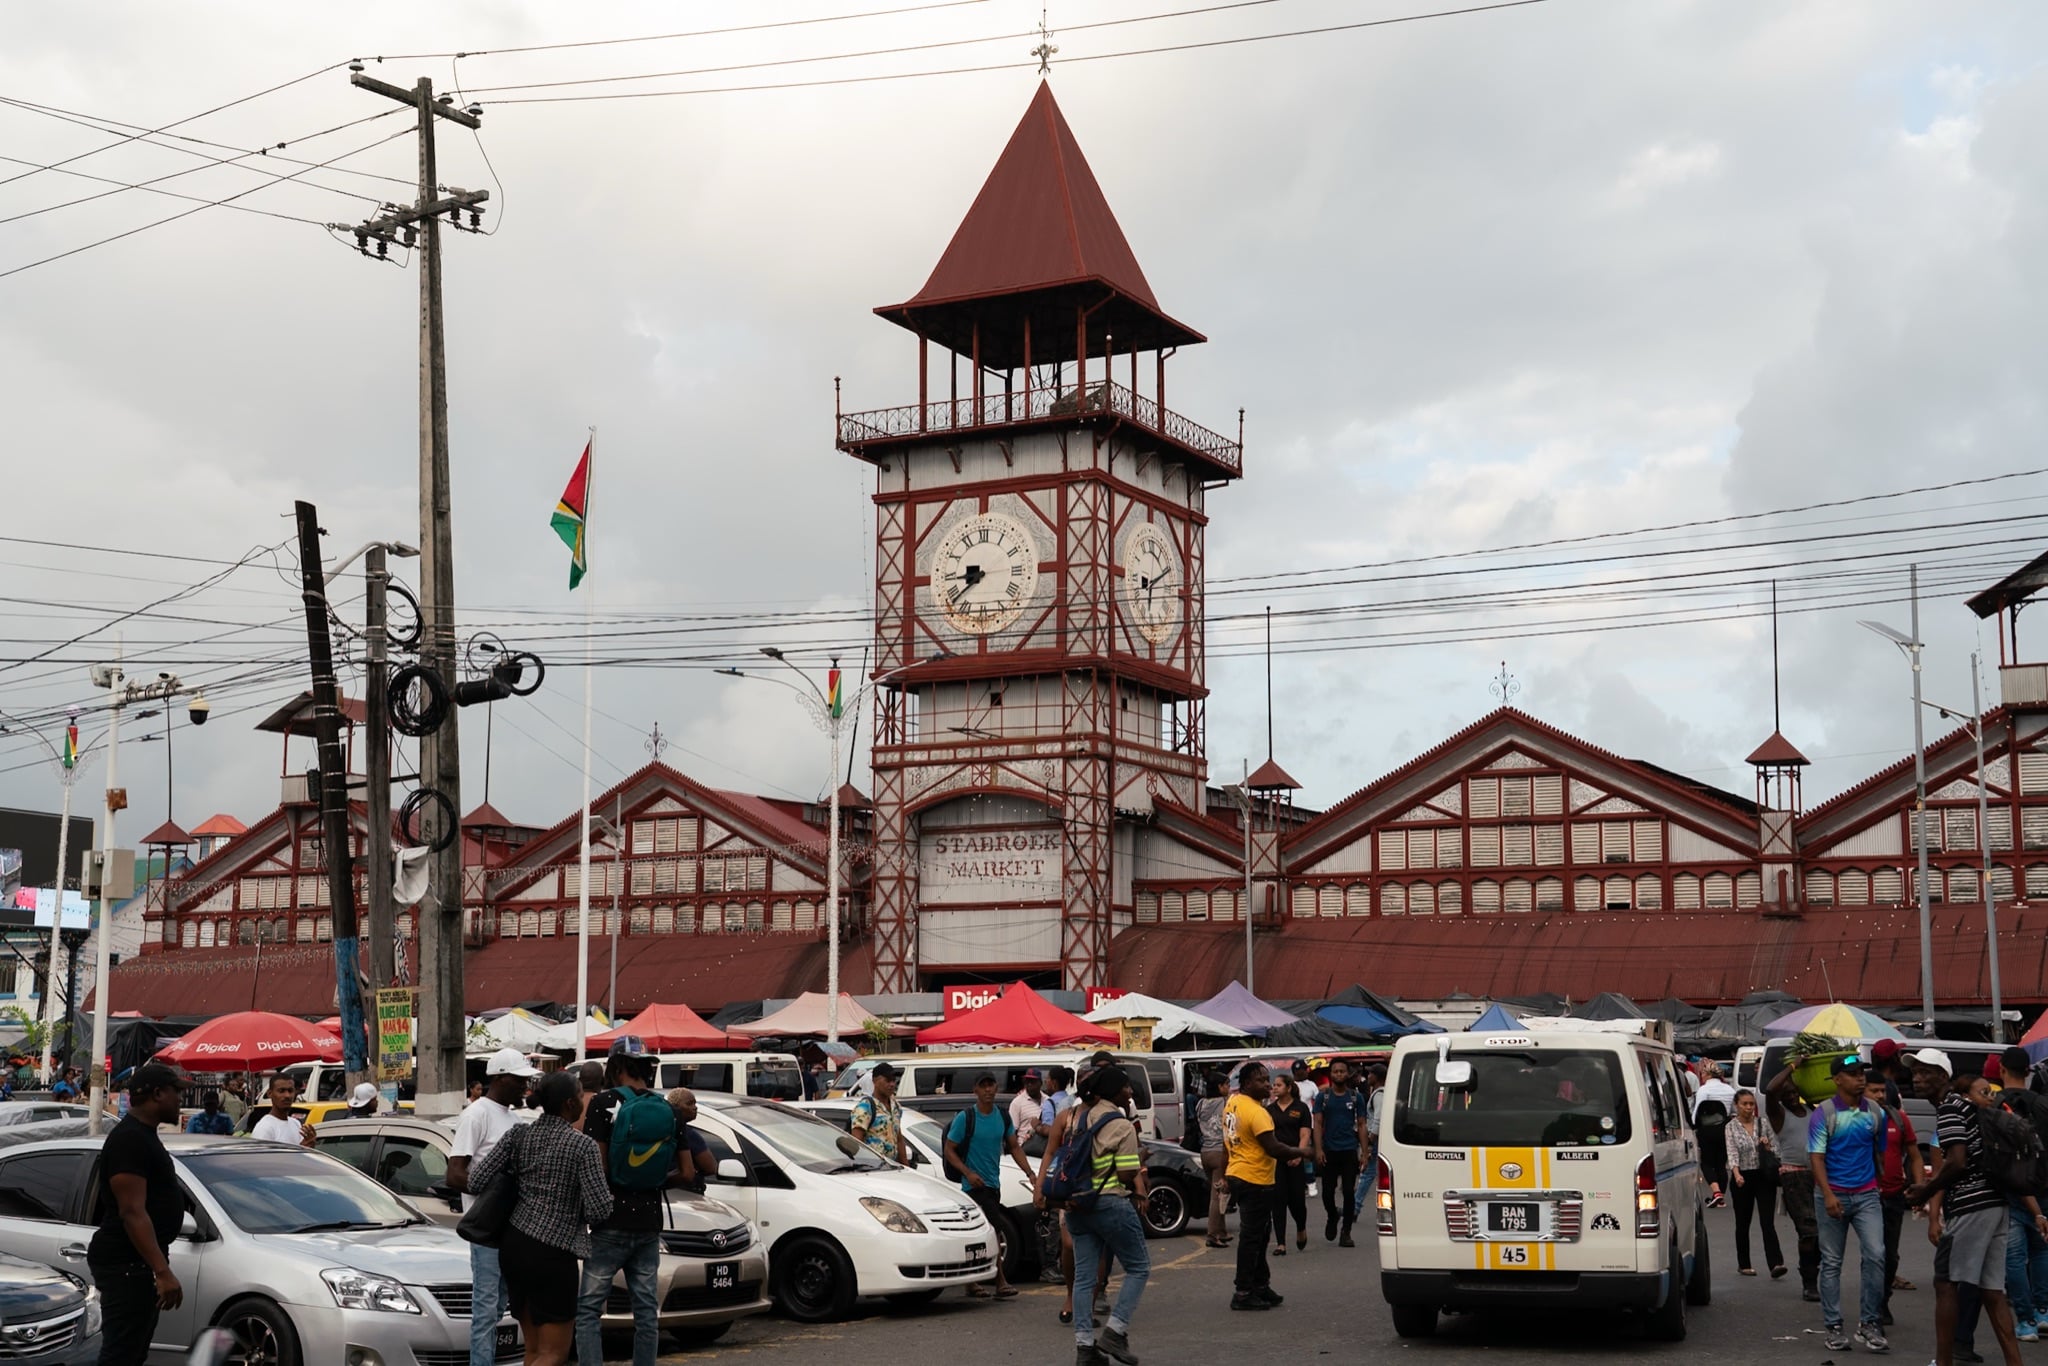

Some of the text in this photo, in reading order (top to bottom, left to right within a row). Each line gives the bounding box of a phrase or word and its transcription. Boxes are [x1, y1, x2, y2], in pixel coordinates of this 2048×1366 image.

[950, 859, 1045, 878] MARKET
[397, 1018, 410, 1034] 14
[196, 1043, 241, 1053] Digicel
[257, 1040, 303, 1052] Digicel
[1427, 1152, 1463, 1160] HOSPITAL
[1561, 1152, 1595, 1160] ALBERT
[1502, 1206, 1526, 1218] BAN
[1500, 1218, 1527, 1230] 1795
[1502, 1246, 1526, 1263] 45
[716, 1265, 729, 1276] HD
[712, 1277, 733, 1288] 5464
